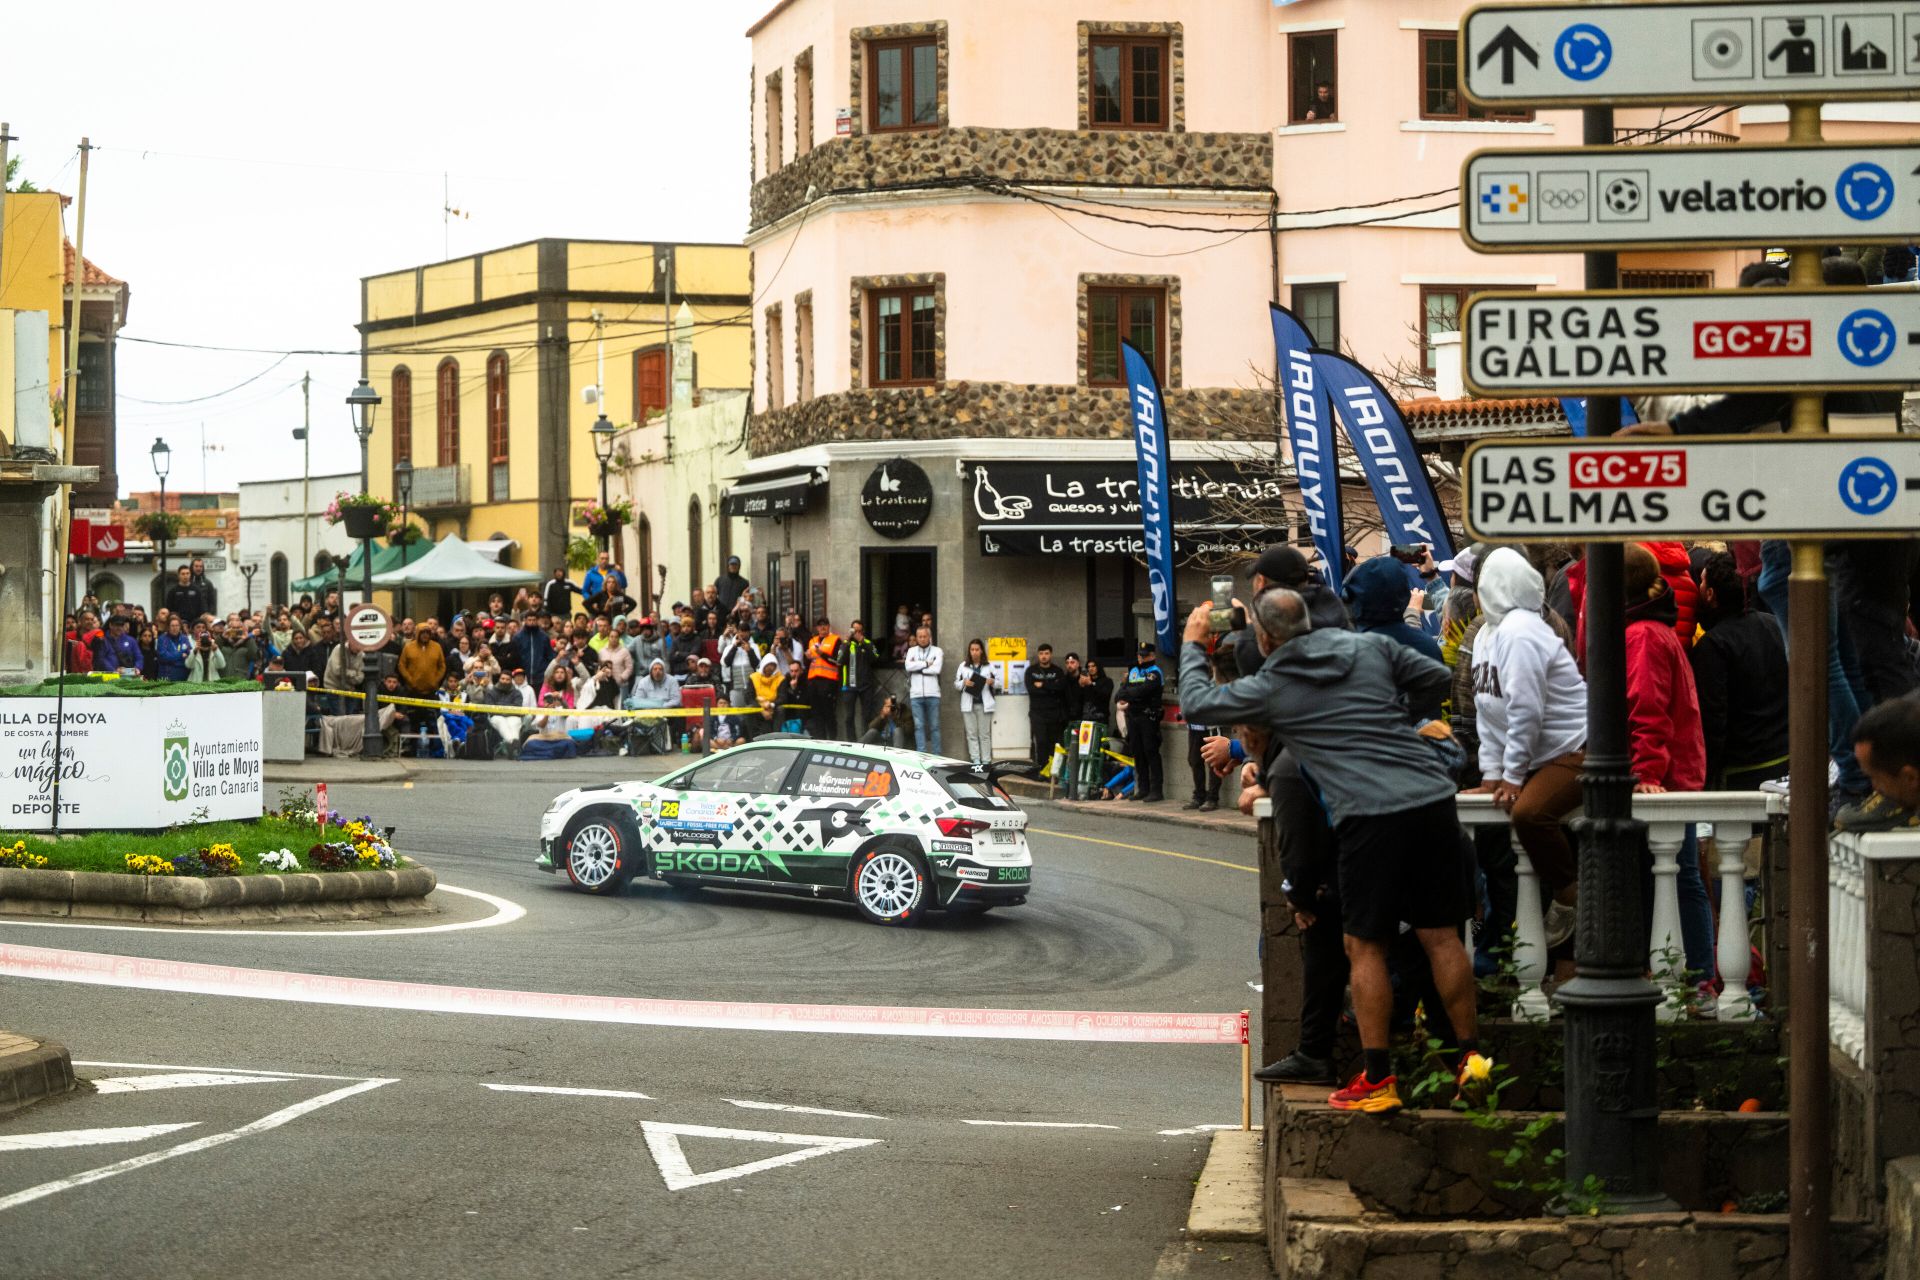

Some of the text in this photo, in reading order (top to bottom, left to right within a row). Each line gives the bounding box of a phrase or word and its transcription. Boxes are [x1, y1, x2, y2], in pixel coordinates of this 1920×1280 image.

[1658, 178, 1827, 213] velatorio
[1478, 306, 1807, 354] FIRGAS GC-75
[1479, 338, 1668, 379] GÁLDAR
[1480, 455, 1682, 485] LAS GC-75
[1046, 474, 1281, 499] La trtienda
[1480, 489, 1768, 523] PALMAS GC
[1040, 535, 1063, 553] La
[37, 713, 58, 724] DE
[63, 713, 107, 724] MOYA
[18, 740, 75, 761] un luar
[193, 739, 259, 759] Ayuntamiento
[192, 757, 259, 779] Villa de Moya
[900, 769, 924, 780] NG
[192, 778, 259, 798] Gran Canaria
[863, 771, 892, 797] 28
[660, 801, 679, 817] 28
